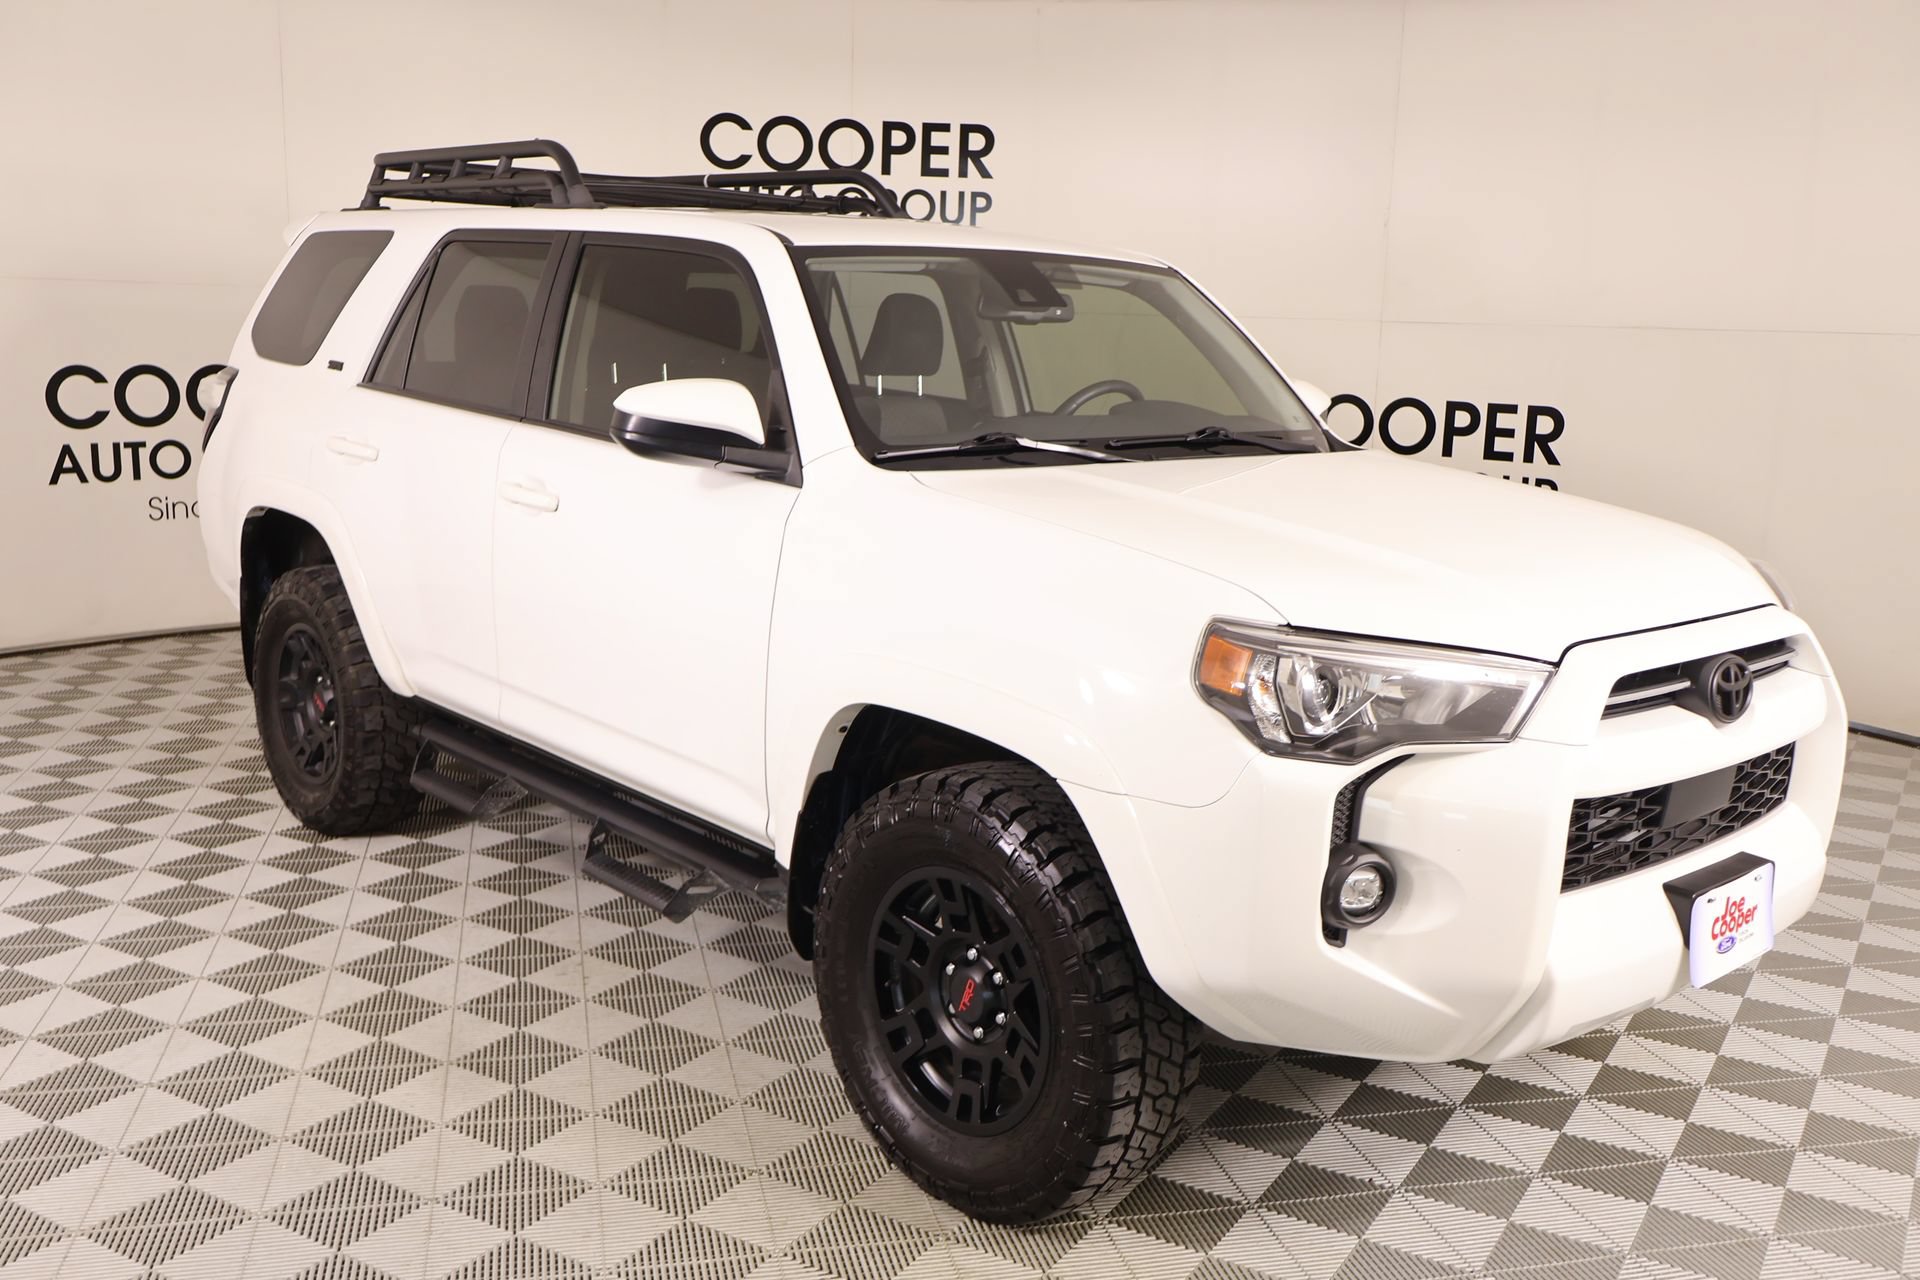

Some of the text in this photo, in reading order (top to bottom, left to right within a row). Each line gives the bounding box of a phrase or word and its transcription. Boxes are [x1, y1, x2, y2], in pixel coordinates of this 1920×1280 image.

[700, 112, 995, 179] COOPER
[49, 439, 192, 486] AUTO
[1711, 904, 1758, 941] Cooper
[1721, 896, 1746, 921] Joe
